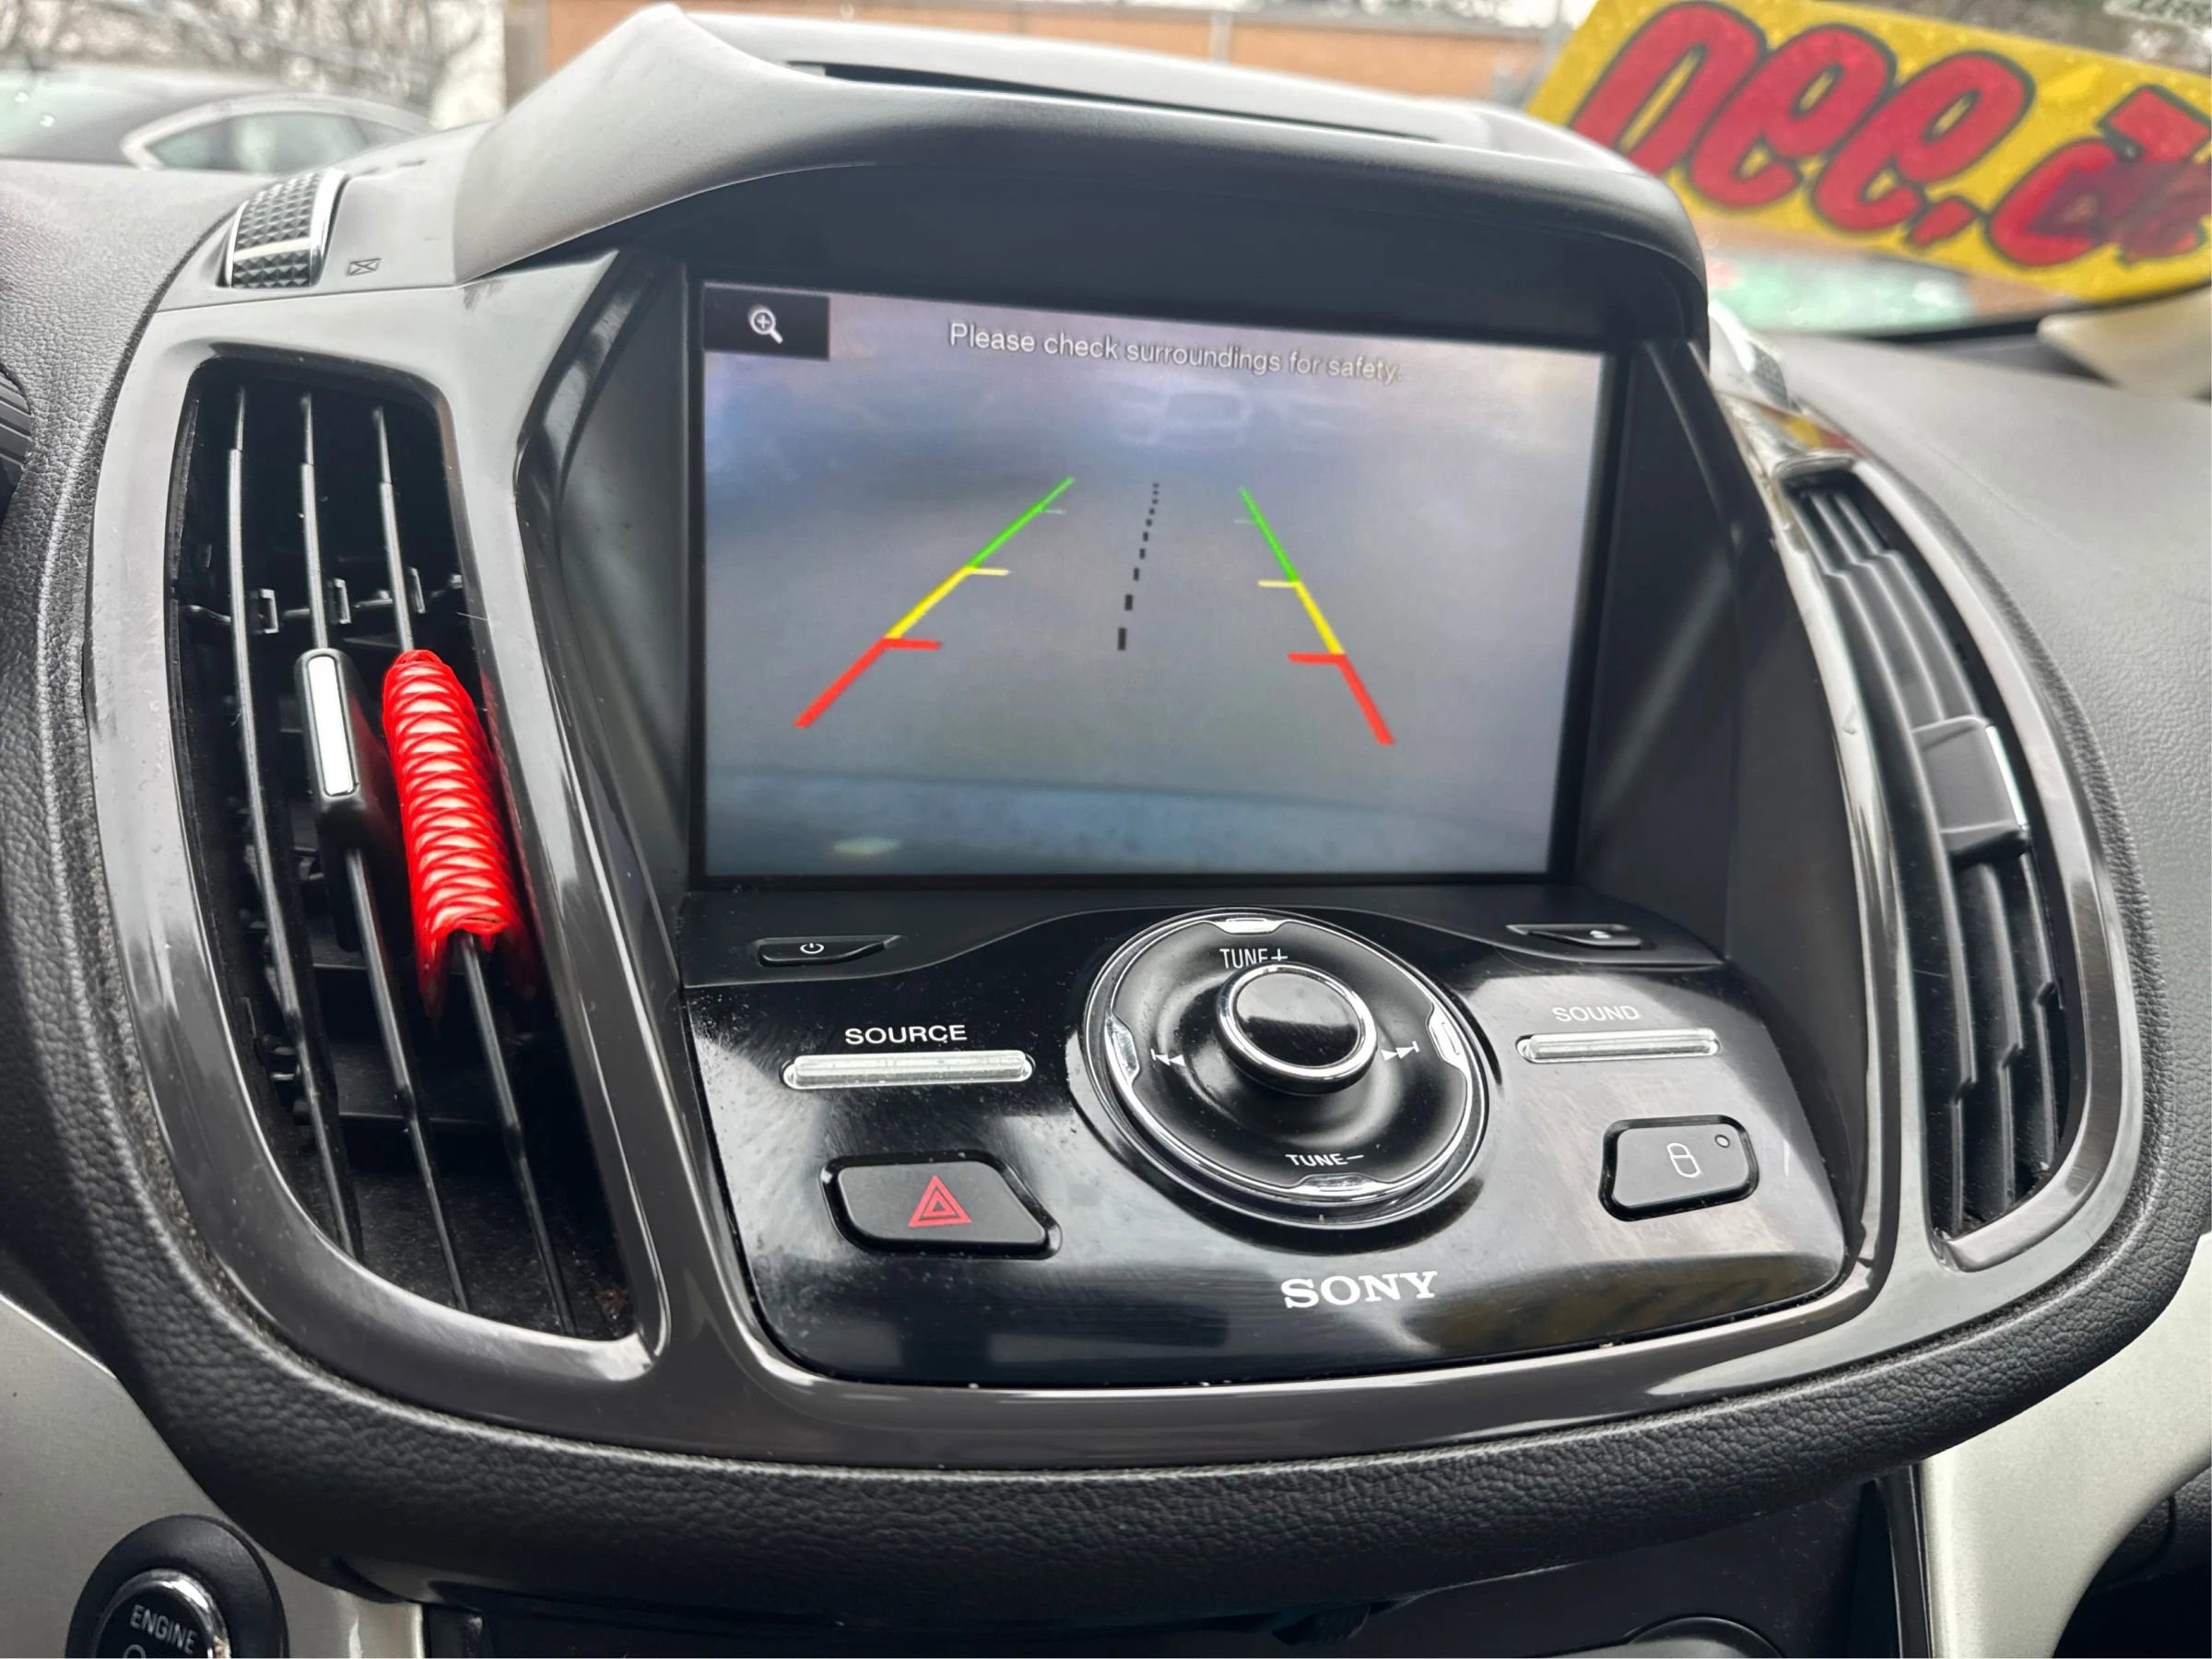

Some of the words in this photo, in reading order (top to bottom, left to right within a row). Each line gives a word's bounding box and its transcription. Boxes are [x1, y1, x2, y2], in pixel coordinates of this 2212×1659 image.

[949, 322, 1036, 353] Please
[1043, 333, 1119, 359] check
[1126, 342, 1280, 375] surroundings
[1289, 350, 1321, 374] for
[1551, 1005, 1641, 1022] SOUND
[844, 1024, 968, 1045] SOURCE
[1280, 1270, 1439, 1310] SONY
[129, 1604, 198, 1654] ENGINE
